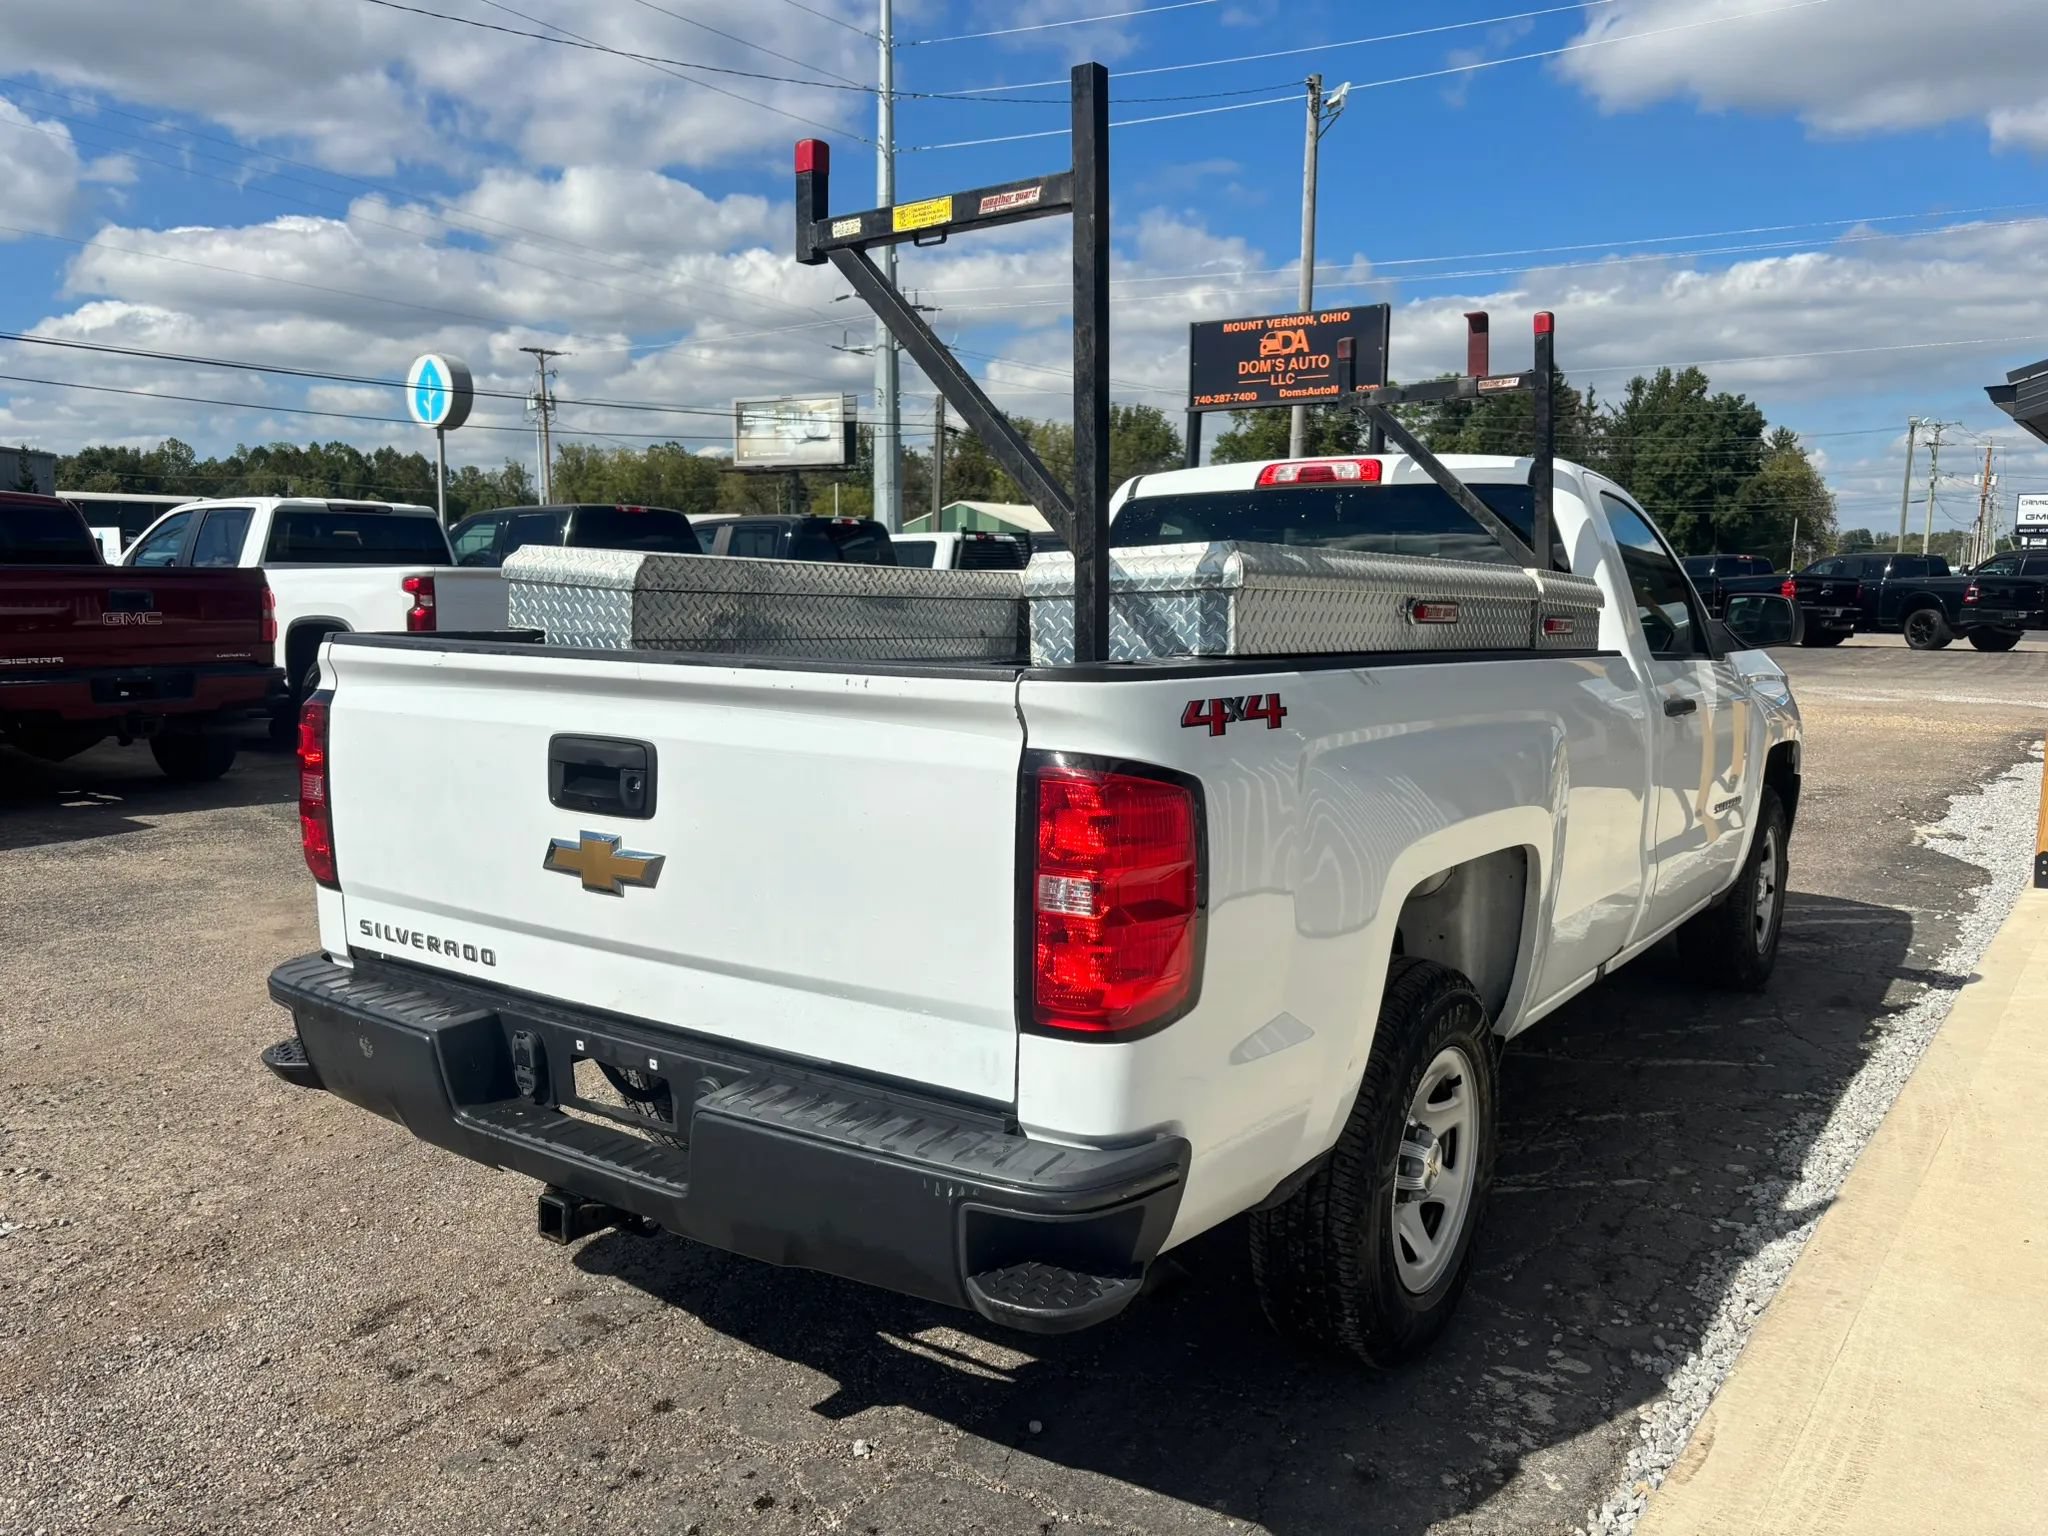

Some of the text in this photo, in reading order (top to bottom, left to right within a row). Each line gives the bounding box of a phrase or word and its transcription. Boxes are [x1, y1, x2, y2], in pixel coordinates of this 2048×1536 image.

[1223, 311, 1351, 333] MOUNT VERNON, OHIO
[1238, 354, 1331, 375] DOM'S AUTO
[1270, 373, 1296, 386] LLC
[1193, 392, 1258, 406] 740-287-7400
[2025, 513, 2048, 521] GM
[102, 611, 163, 625] GMC
[0, 656, 64, 665] SIERRA
[359, 918, 497, 967] SILVERADO
